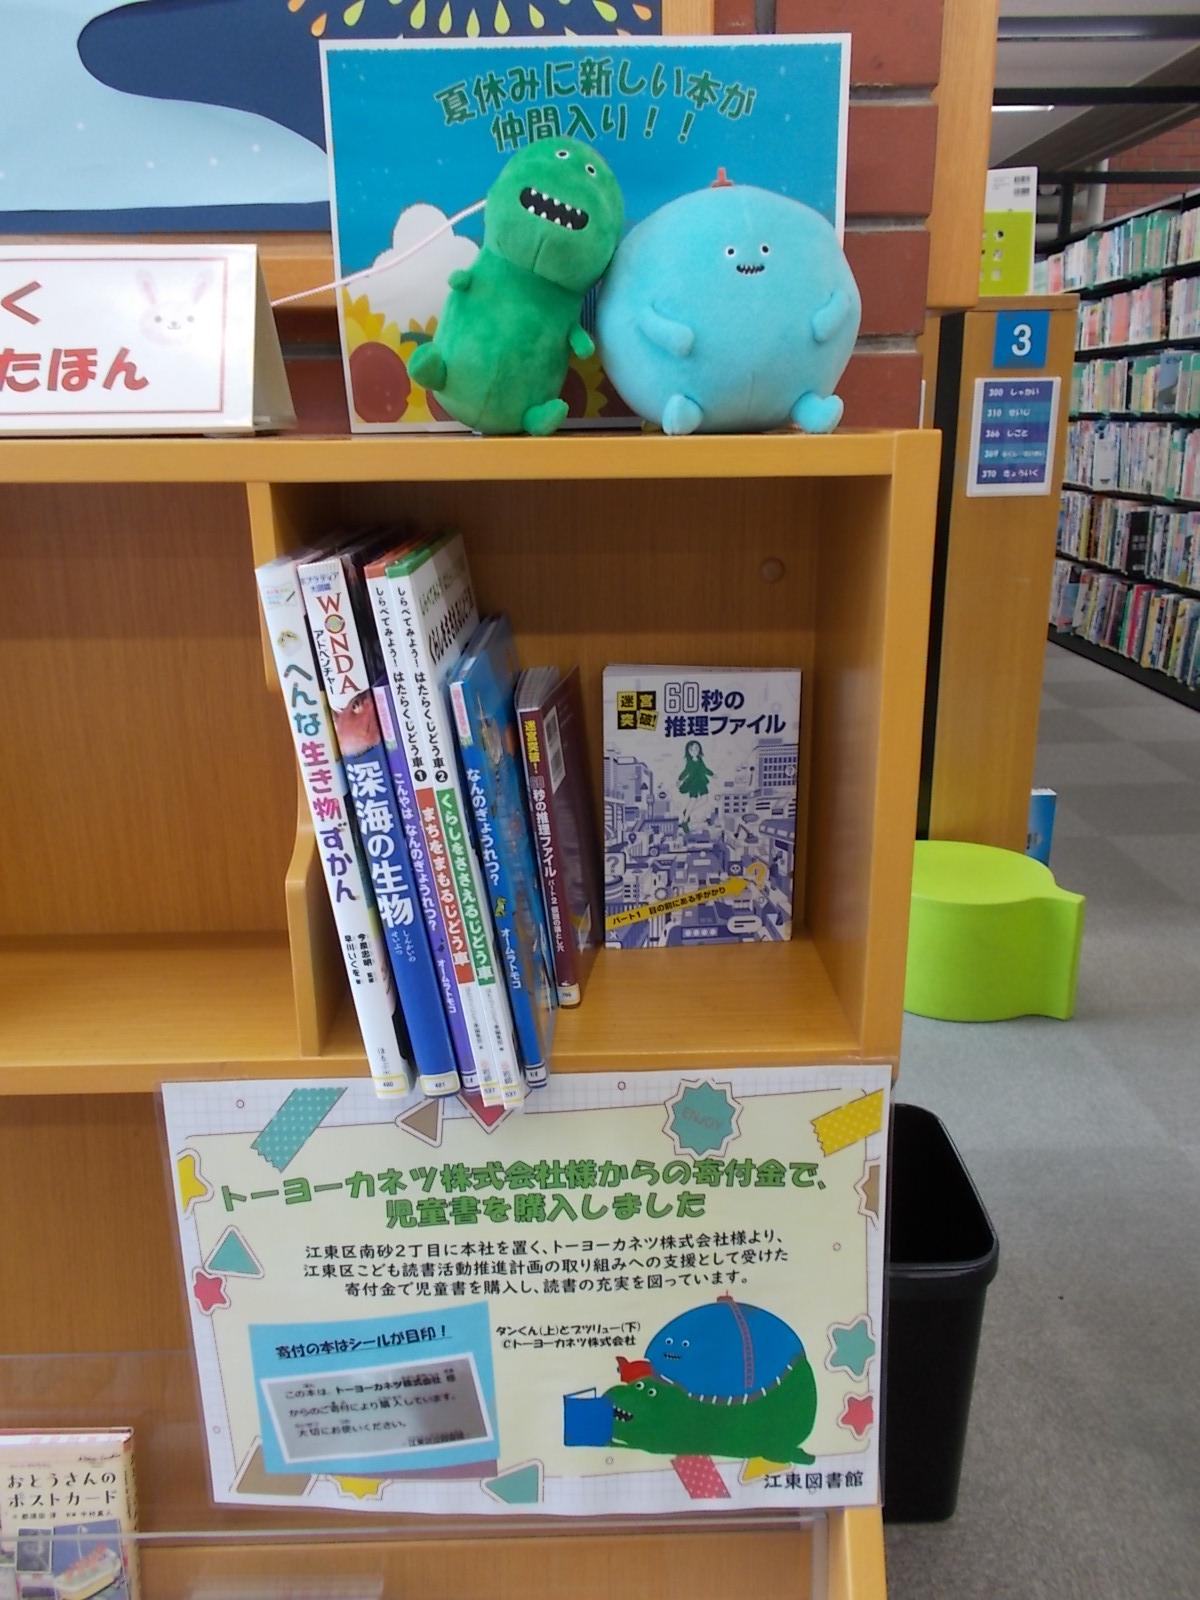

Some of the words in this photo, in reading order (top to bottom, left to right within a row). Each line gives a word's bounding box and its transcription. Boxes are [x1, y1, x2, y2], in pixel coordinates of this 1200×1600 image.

[434, 57, 756, 126] 夏休みに新しい本が
[490, 103, 695, 152] 仲間入り！！
[1011, 323, 1032, 357] 3
[0, 346, 150, 392] たほん
[988, 388, 1004, 397] 300
[1010, 387, 1039, 397] しゃかい
[987, 408, 1002, 417] 310
[1009, 408, 1030, 417] せいじ
[1007, 428, 1028, 438] しごと
[981, 469, 997, 478] 370
[1003, 469, 1039, 479] きょういく
[316, 592, 361, 694] WONDA
[376, 587, 398, 667] しらべてみよう！
[393, 672, 424, 767] はたらくじどう車
[397, 587, 420, 668] しらべてみよう！
[414, 672, 445, 769] はたらくじどう車
[617, 690, 657, 710] 迷宮
[664, 682, 745, 714] 60秒の
[664, 714, 786, 738] 推理ファイル
[283, 663, 357, 903] へんな生き物ずかん
[394, 773, 414, 819] こんやは
[346, 761, 414, 928] 深海の生物
[421, 806, 470, 966] まちをまもるじどう車
[441, 794, 493, 980] くらしをささえるじどう車
[221, 1159, 826, 1213] トーヨーカネツ株式会社様からの寄付金で、
[386, 1192, 706, 1229] 児童書を購入しました
[305, 1229, 783, 1259] 江東区南砂2丁目に本社を置く、トーヨーカネツ株式会社様より、
[303, 1247, 788, 1278] 江東区こども読書活動推進計画の取り組みへの支援として受けた
[344, 1268, 748, 1297] 寄付金で児童書を購入し、読書の充実を図っています。
[275, 1325, 447, 1359] 寄付の本はシールが目印！
[8, 1472, 116, 1489] おとうさんの
[763, 1469, 864, 1490] 江東図書館
[9, 1490, 117, 1508] ポストカード
